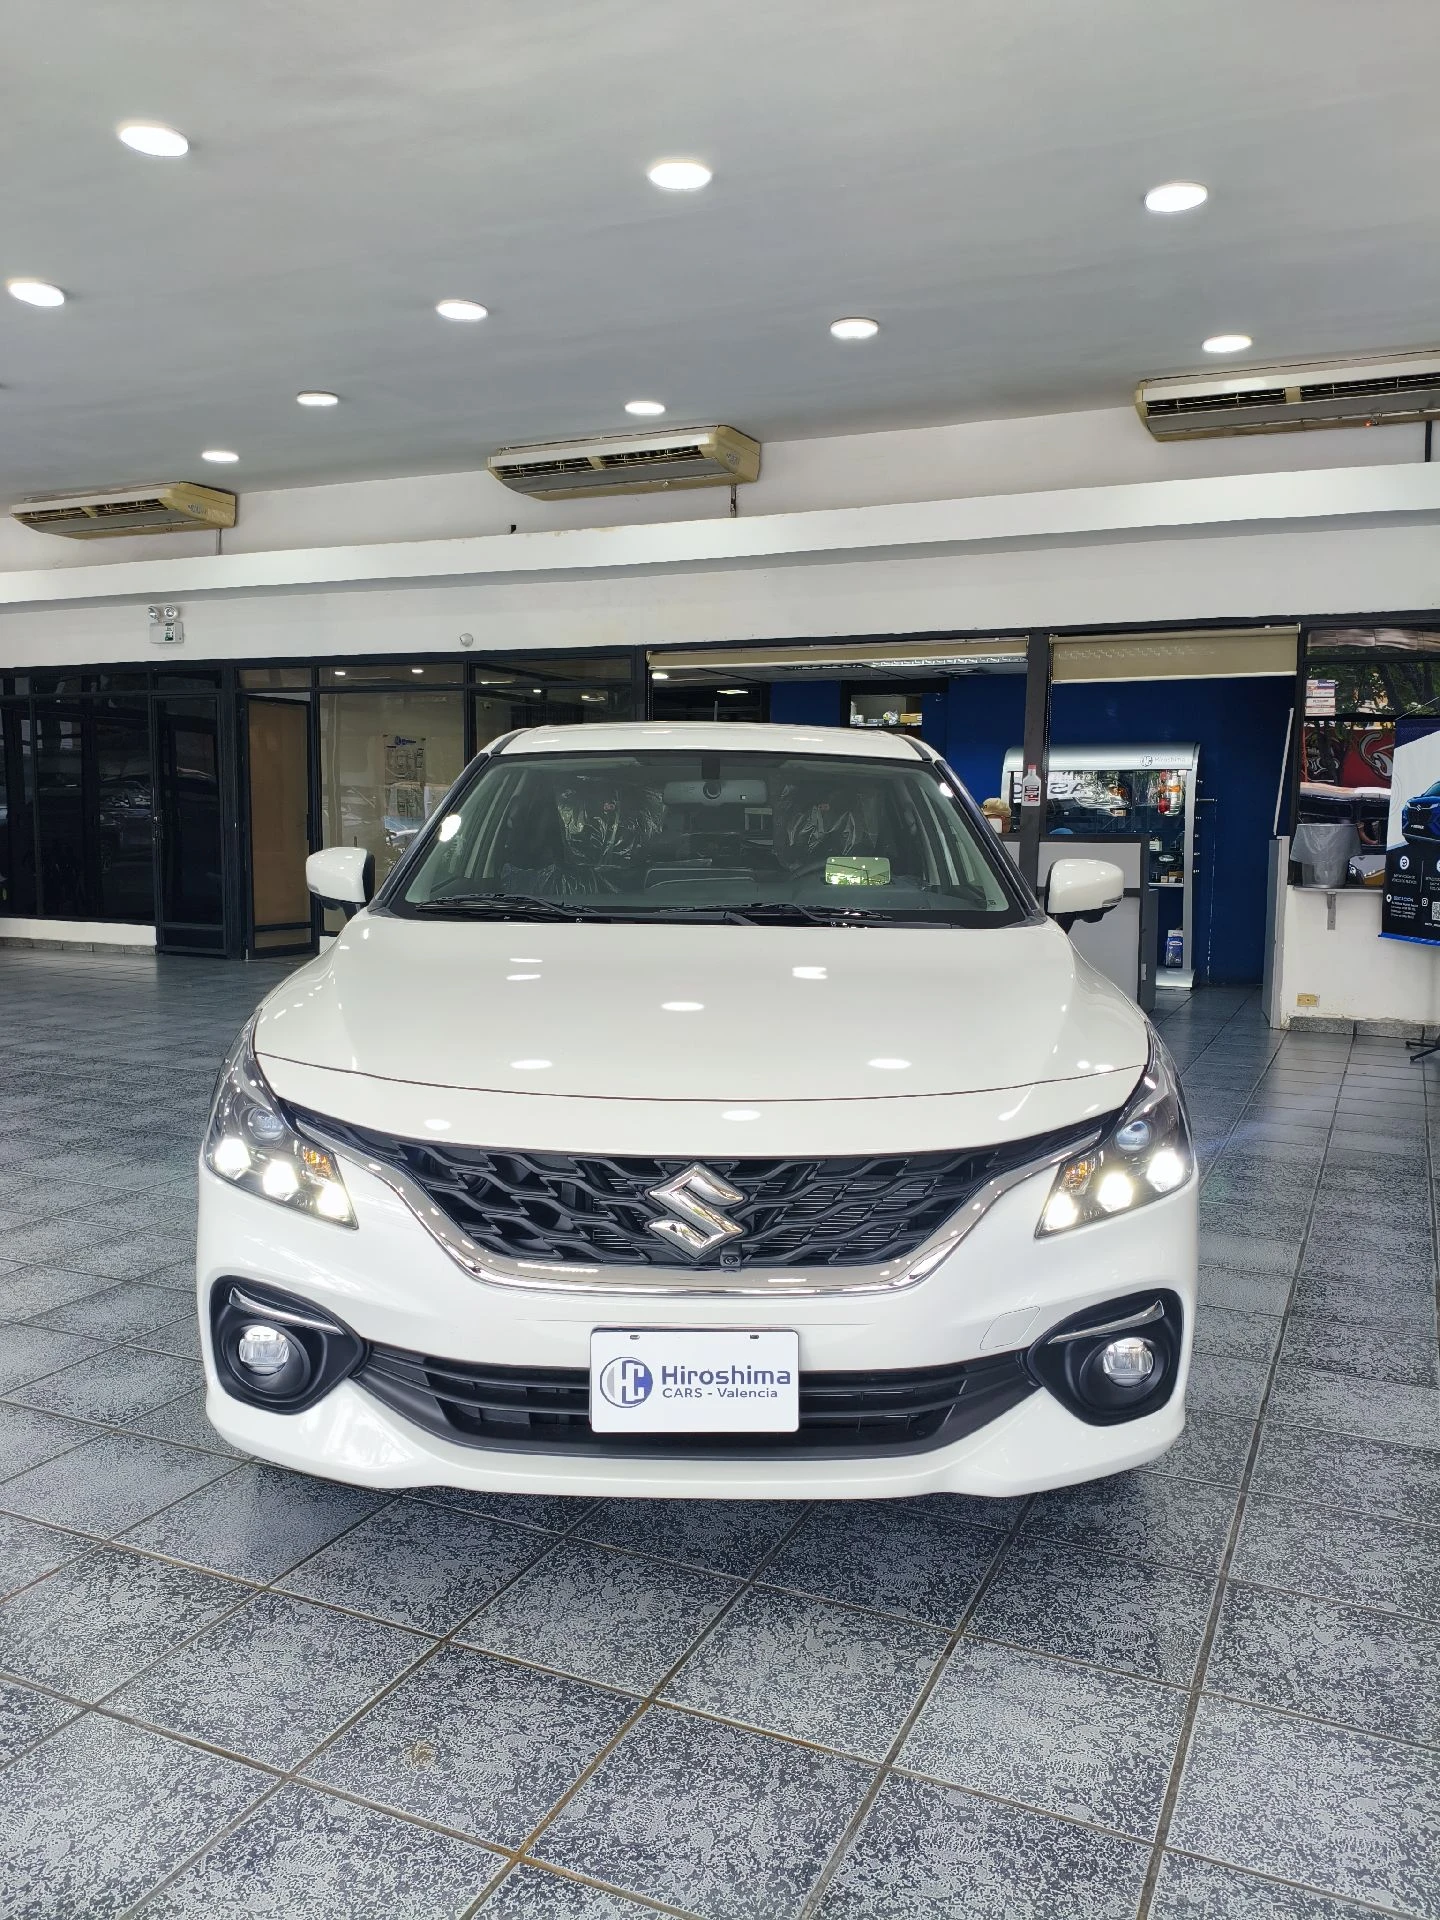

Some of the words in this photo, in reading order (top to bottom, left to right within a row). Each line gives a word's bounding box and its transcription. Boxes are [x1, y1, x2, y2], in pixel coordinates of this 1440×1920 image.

[661, 1364, 791, 1386] Hiroshima
[662, 1387, 703, 1399] CARS
[717, 1387, 778, 1398] Valencia
